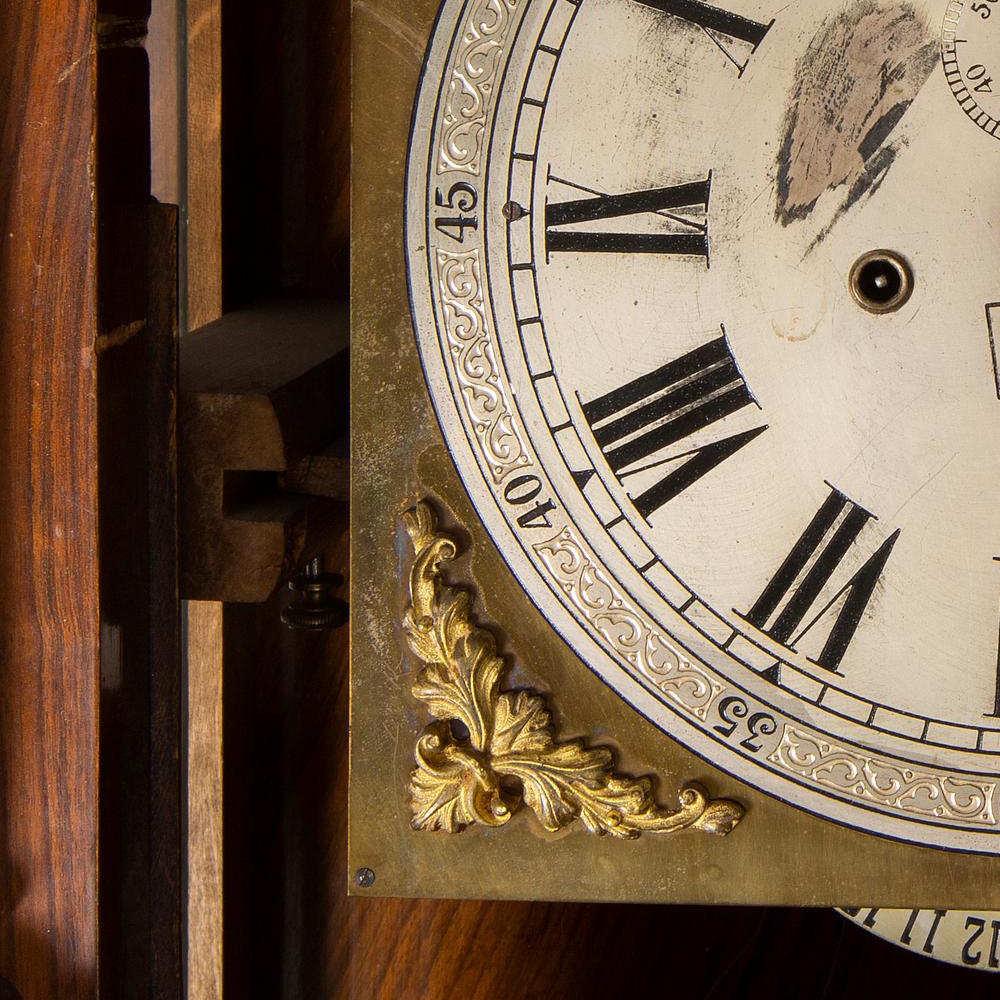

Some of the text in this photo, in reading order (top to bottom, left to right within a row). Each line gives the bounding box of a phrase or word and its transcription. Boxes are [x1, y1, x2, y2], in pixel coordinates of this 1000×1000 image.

[966, 64, 994, 94] 40
[434, 181, 479, 244] 45
[545, 164, 713, 269] IX
[575, 323, 770, 529] VIII
[503, 474, 557, 529] 40
[732, 479, 901, 678] VII
[713, 696, 778, 753] 35
